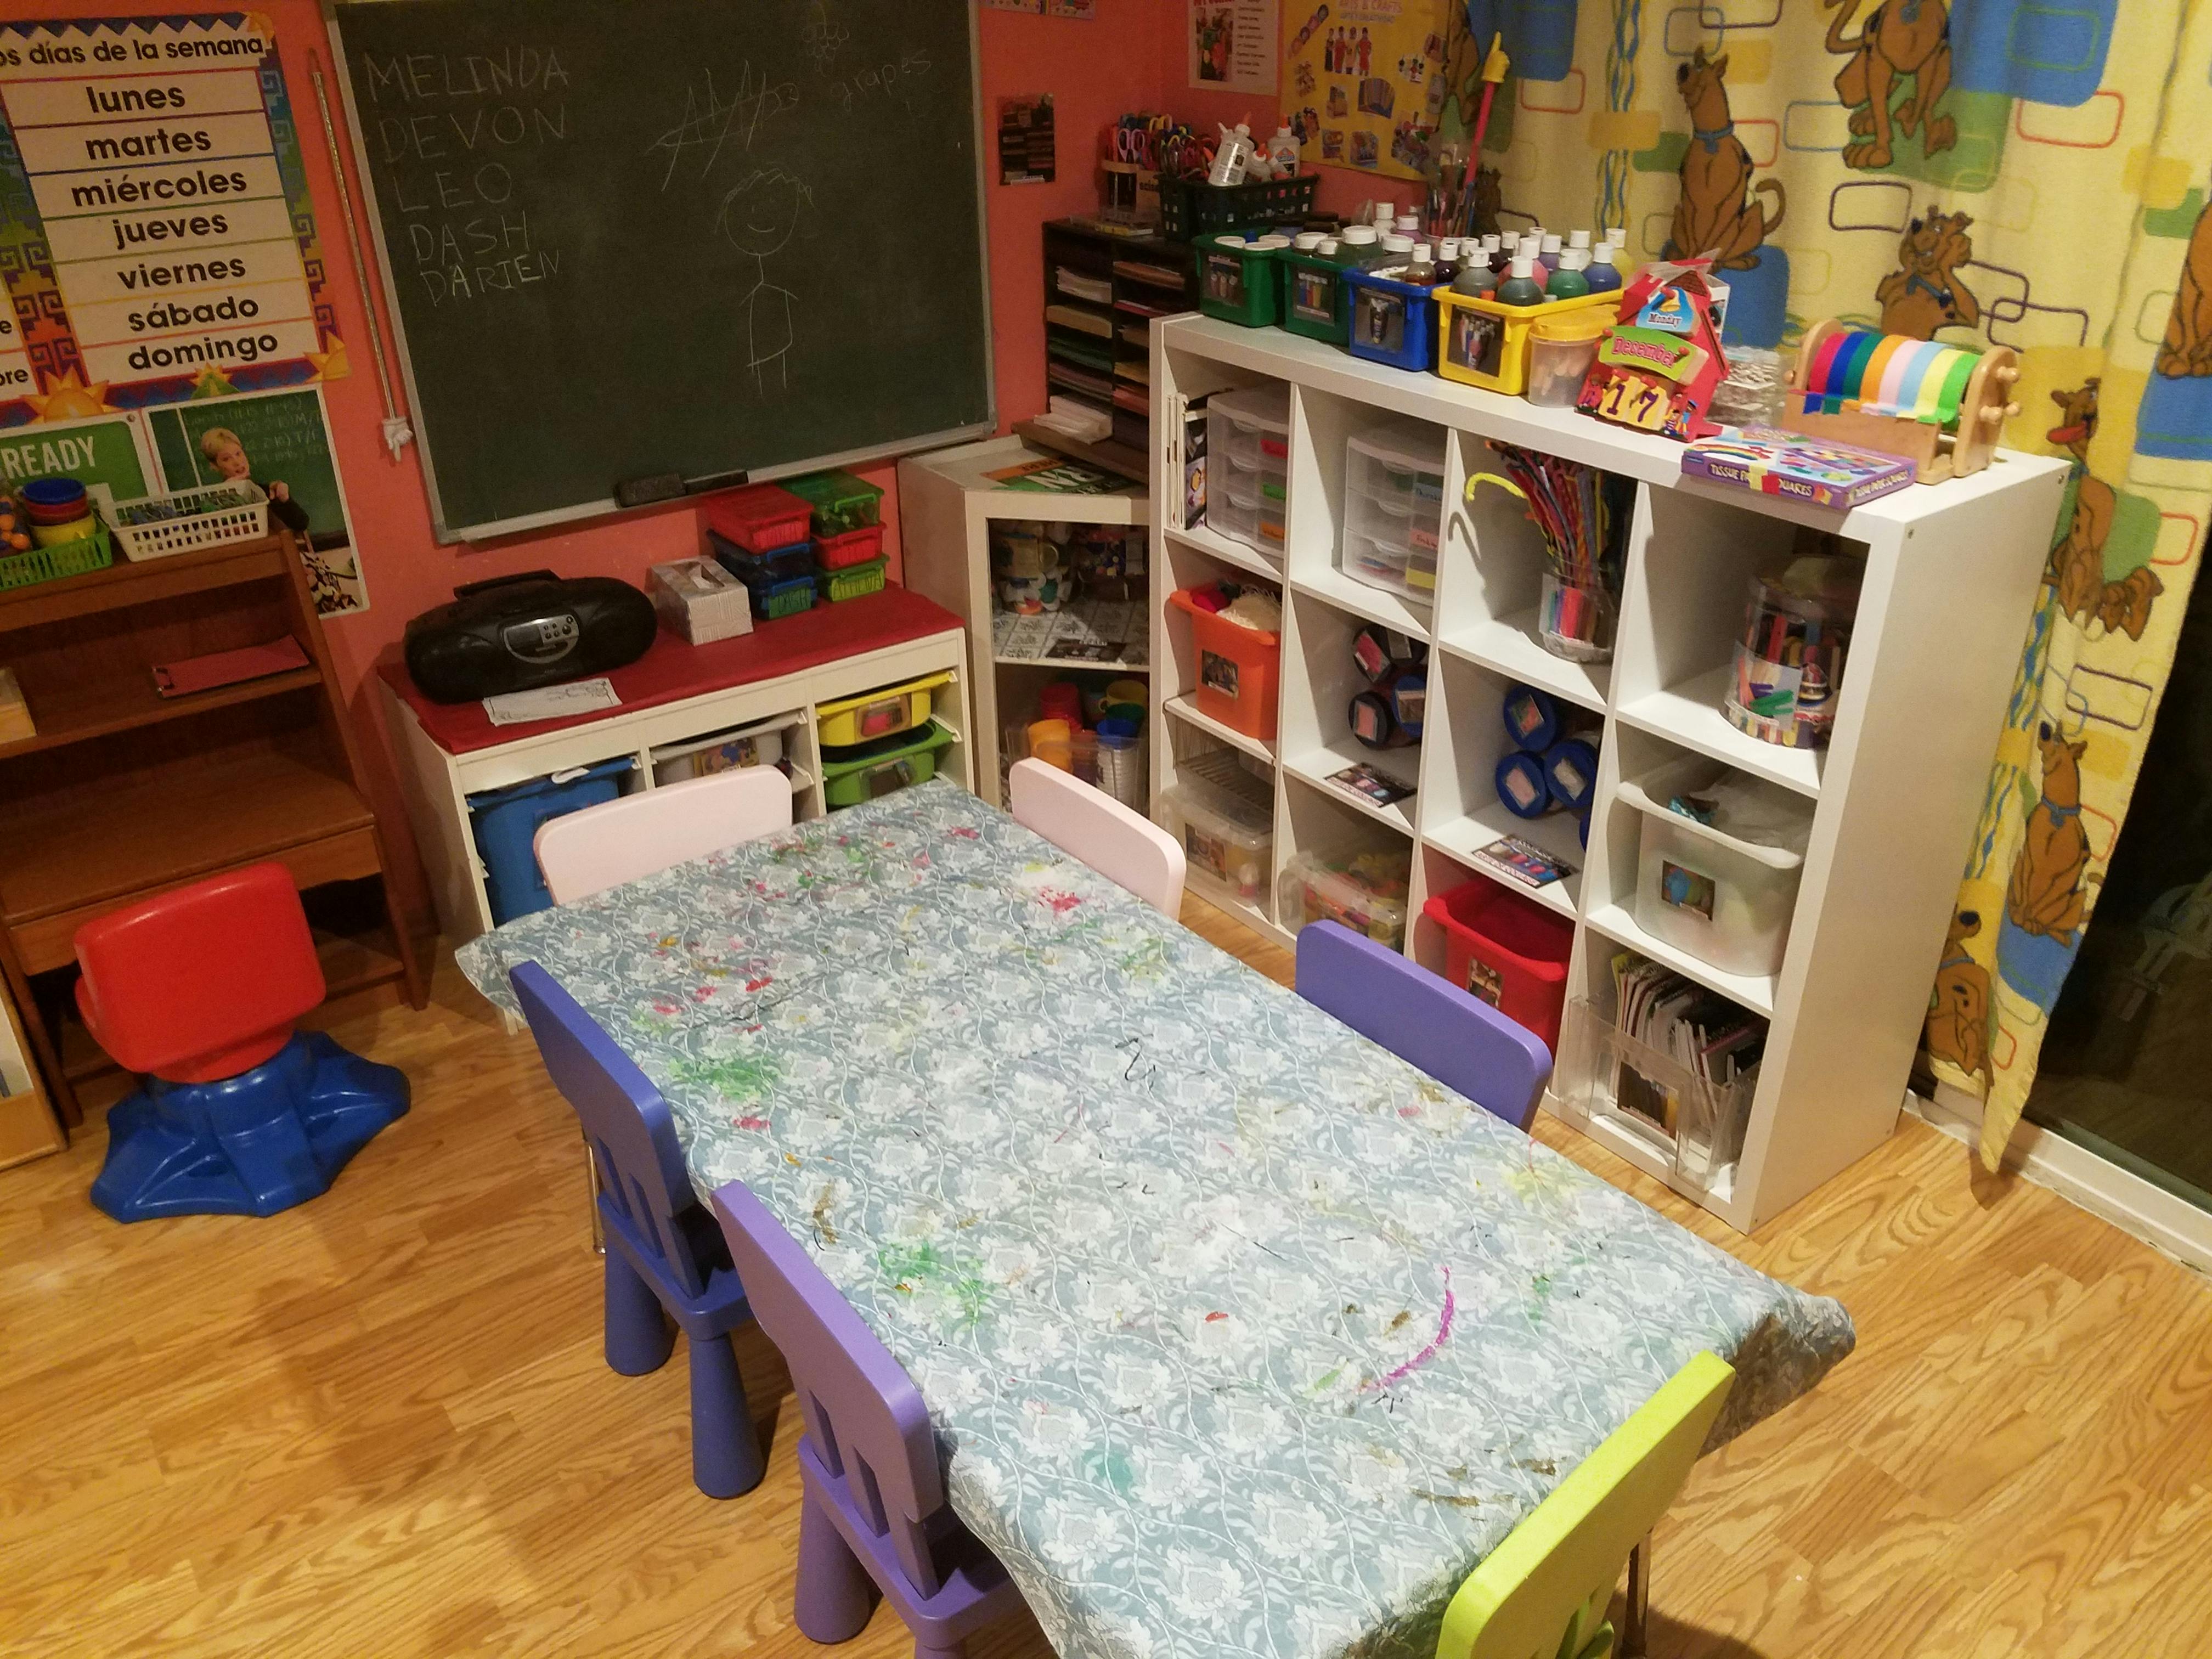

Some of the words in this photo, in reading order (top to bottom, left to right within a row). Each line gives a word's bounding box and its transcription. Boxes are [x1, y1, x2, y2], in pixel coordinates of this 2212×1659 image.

[29, 40, 86, 65] días
[93, 40, 127, 62] de
[133, 39, 160, 60] la
[166, 36, 264, 58] semana
[364, 44, 569, 103] MELINDA
[831, 50, 932, 112] grapes
[86, 86, 186, 114] lunes
[85, 127, 212, 160] martes
[378, 103, 566, 163] DEVON
[71, 169, 247, 207] miércoles
[393, 162, 513, 213] LEO
[111, 211, 229, 250] jueves
[409, 210, 530, 266] DASH
[117, 256, 247, 290] viernes
[420, 249, 560, 307] DARIEN
[128, 295, 259, 332] sábado
[1647, 312, 1682, 329] Monday
[127, 334, 278, 370] domingo
[2, 436, 97, 479] READY
[1710, 464, 1739, 481] TISSUE
